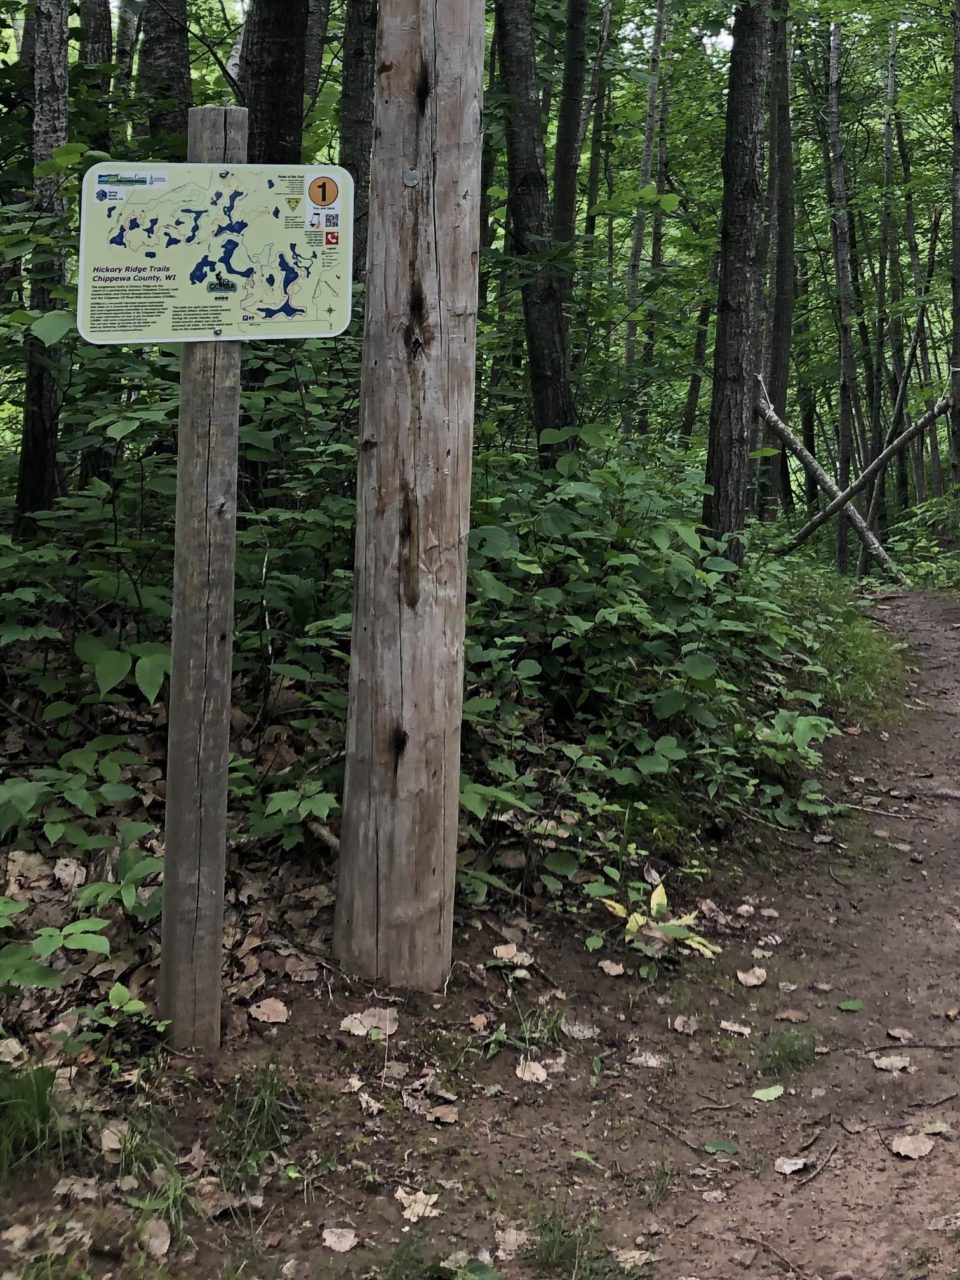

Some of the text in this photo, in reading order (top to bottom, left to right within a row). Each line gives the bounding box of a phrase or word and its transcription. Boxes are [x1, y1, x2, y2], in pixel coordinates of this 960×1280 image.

[317, 181, 327, 202] 1
[92, 265, 171, 274] Hickory Ridge Trails
[92, 275, 131, 283] Chippewa
[133, 274, 162, 282] County,
